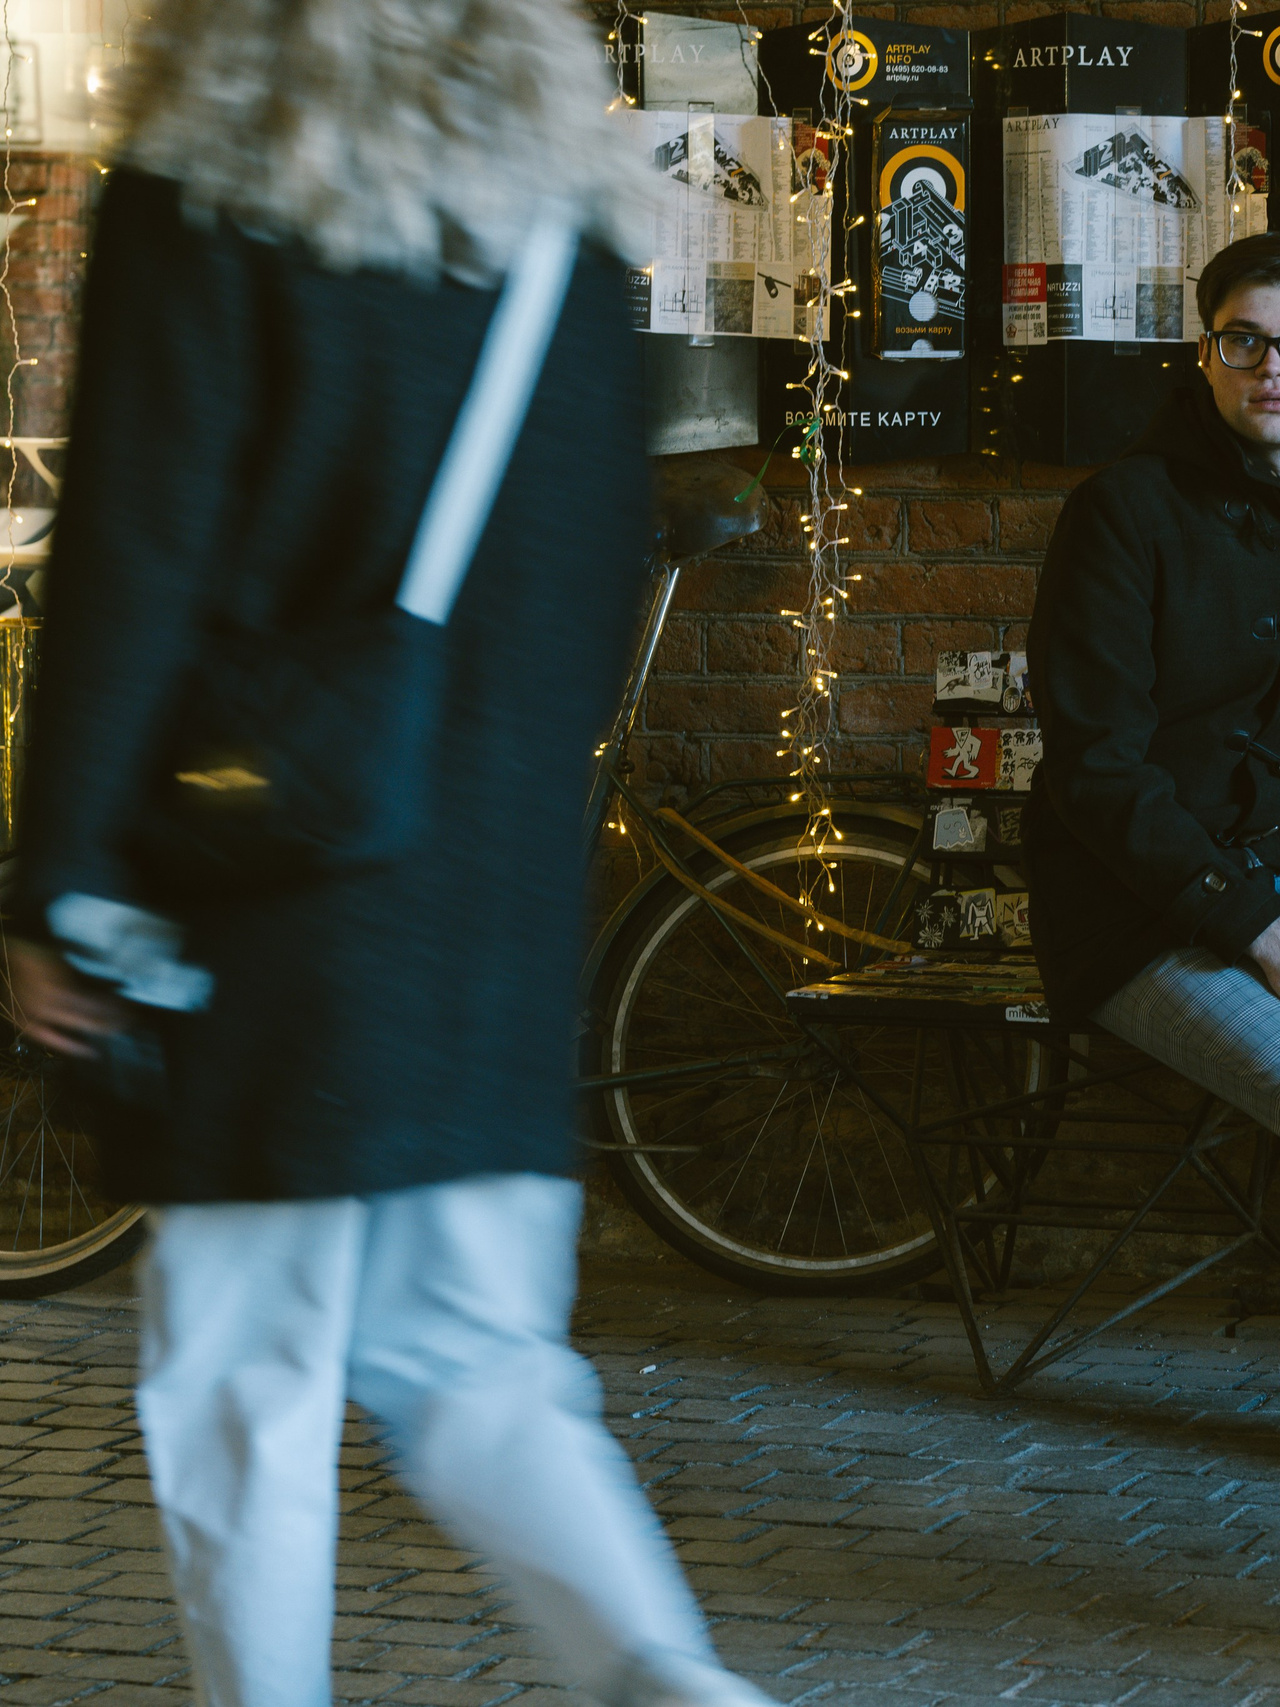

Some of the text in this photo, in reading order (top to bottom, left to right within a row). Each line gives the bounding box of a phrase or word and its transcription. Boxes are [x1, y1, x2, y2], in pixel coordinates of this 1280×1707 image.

[886, 44, 931, 54] ARTPLAY
[886, 54, 912, 64] INFO
[1013, 45, 1134, 68] ARTPLAY
[886, 65, 949, 74] 8 (495) 620-08-83
[886, 74, 919, 83] artplay.ru
[1006, 118, 1059, 132] ARTPLAY
[889, 127, 958, 139] ARTPLAY
[1047, 282, 1081, 292] NATUZZI
[895, 326, 953, 336] возьми карту
[878, 411, 942, 427] КАРТУ
